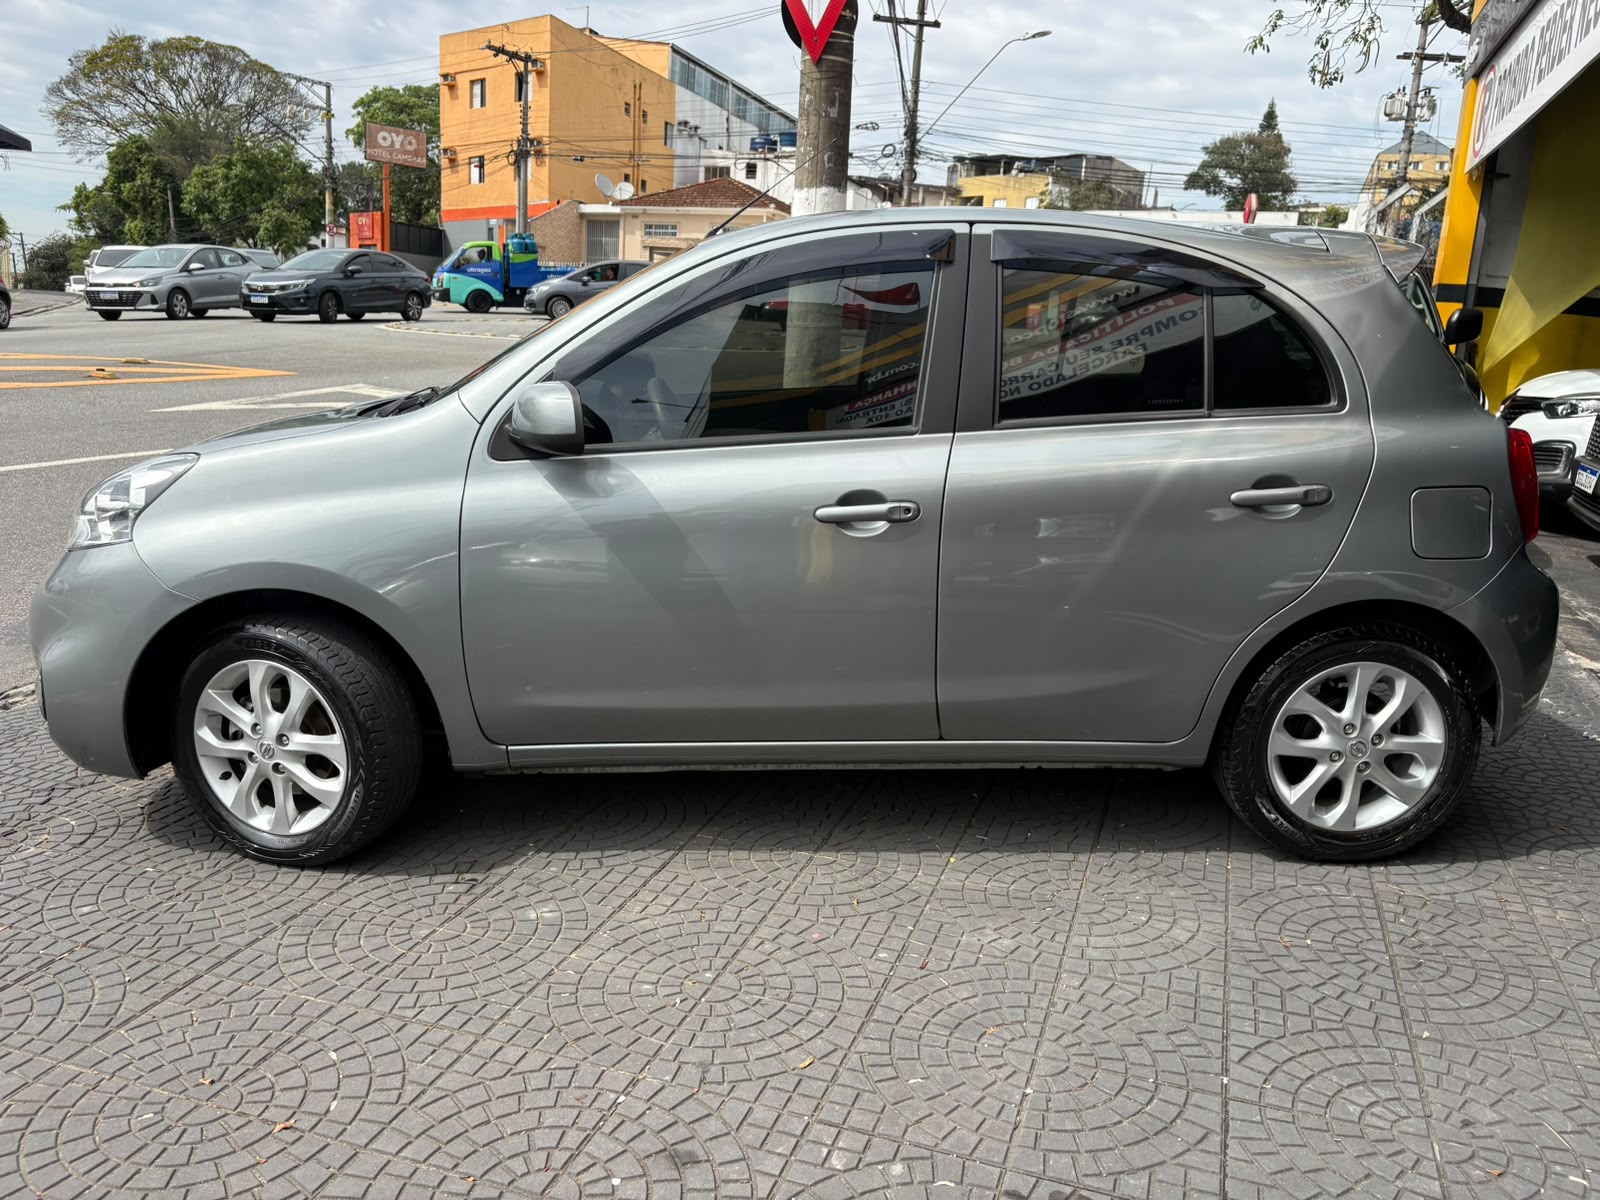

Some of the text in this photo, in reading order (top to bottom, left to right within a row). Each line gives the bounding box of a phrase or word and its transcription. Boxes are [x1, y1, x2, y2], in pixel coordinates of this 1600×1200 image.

[1491, 35, 1536, 132] PROIBIDO
[1531, 0, 1579, 92] PERDER
[377, 131, 418, 151] OYO
[366, 148, 392, 158] HOTEL
[466, 266, 492, 275] ultragaz
